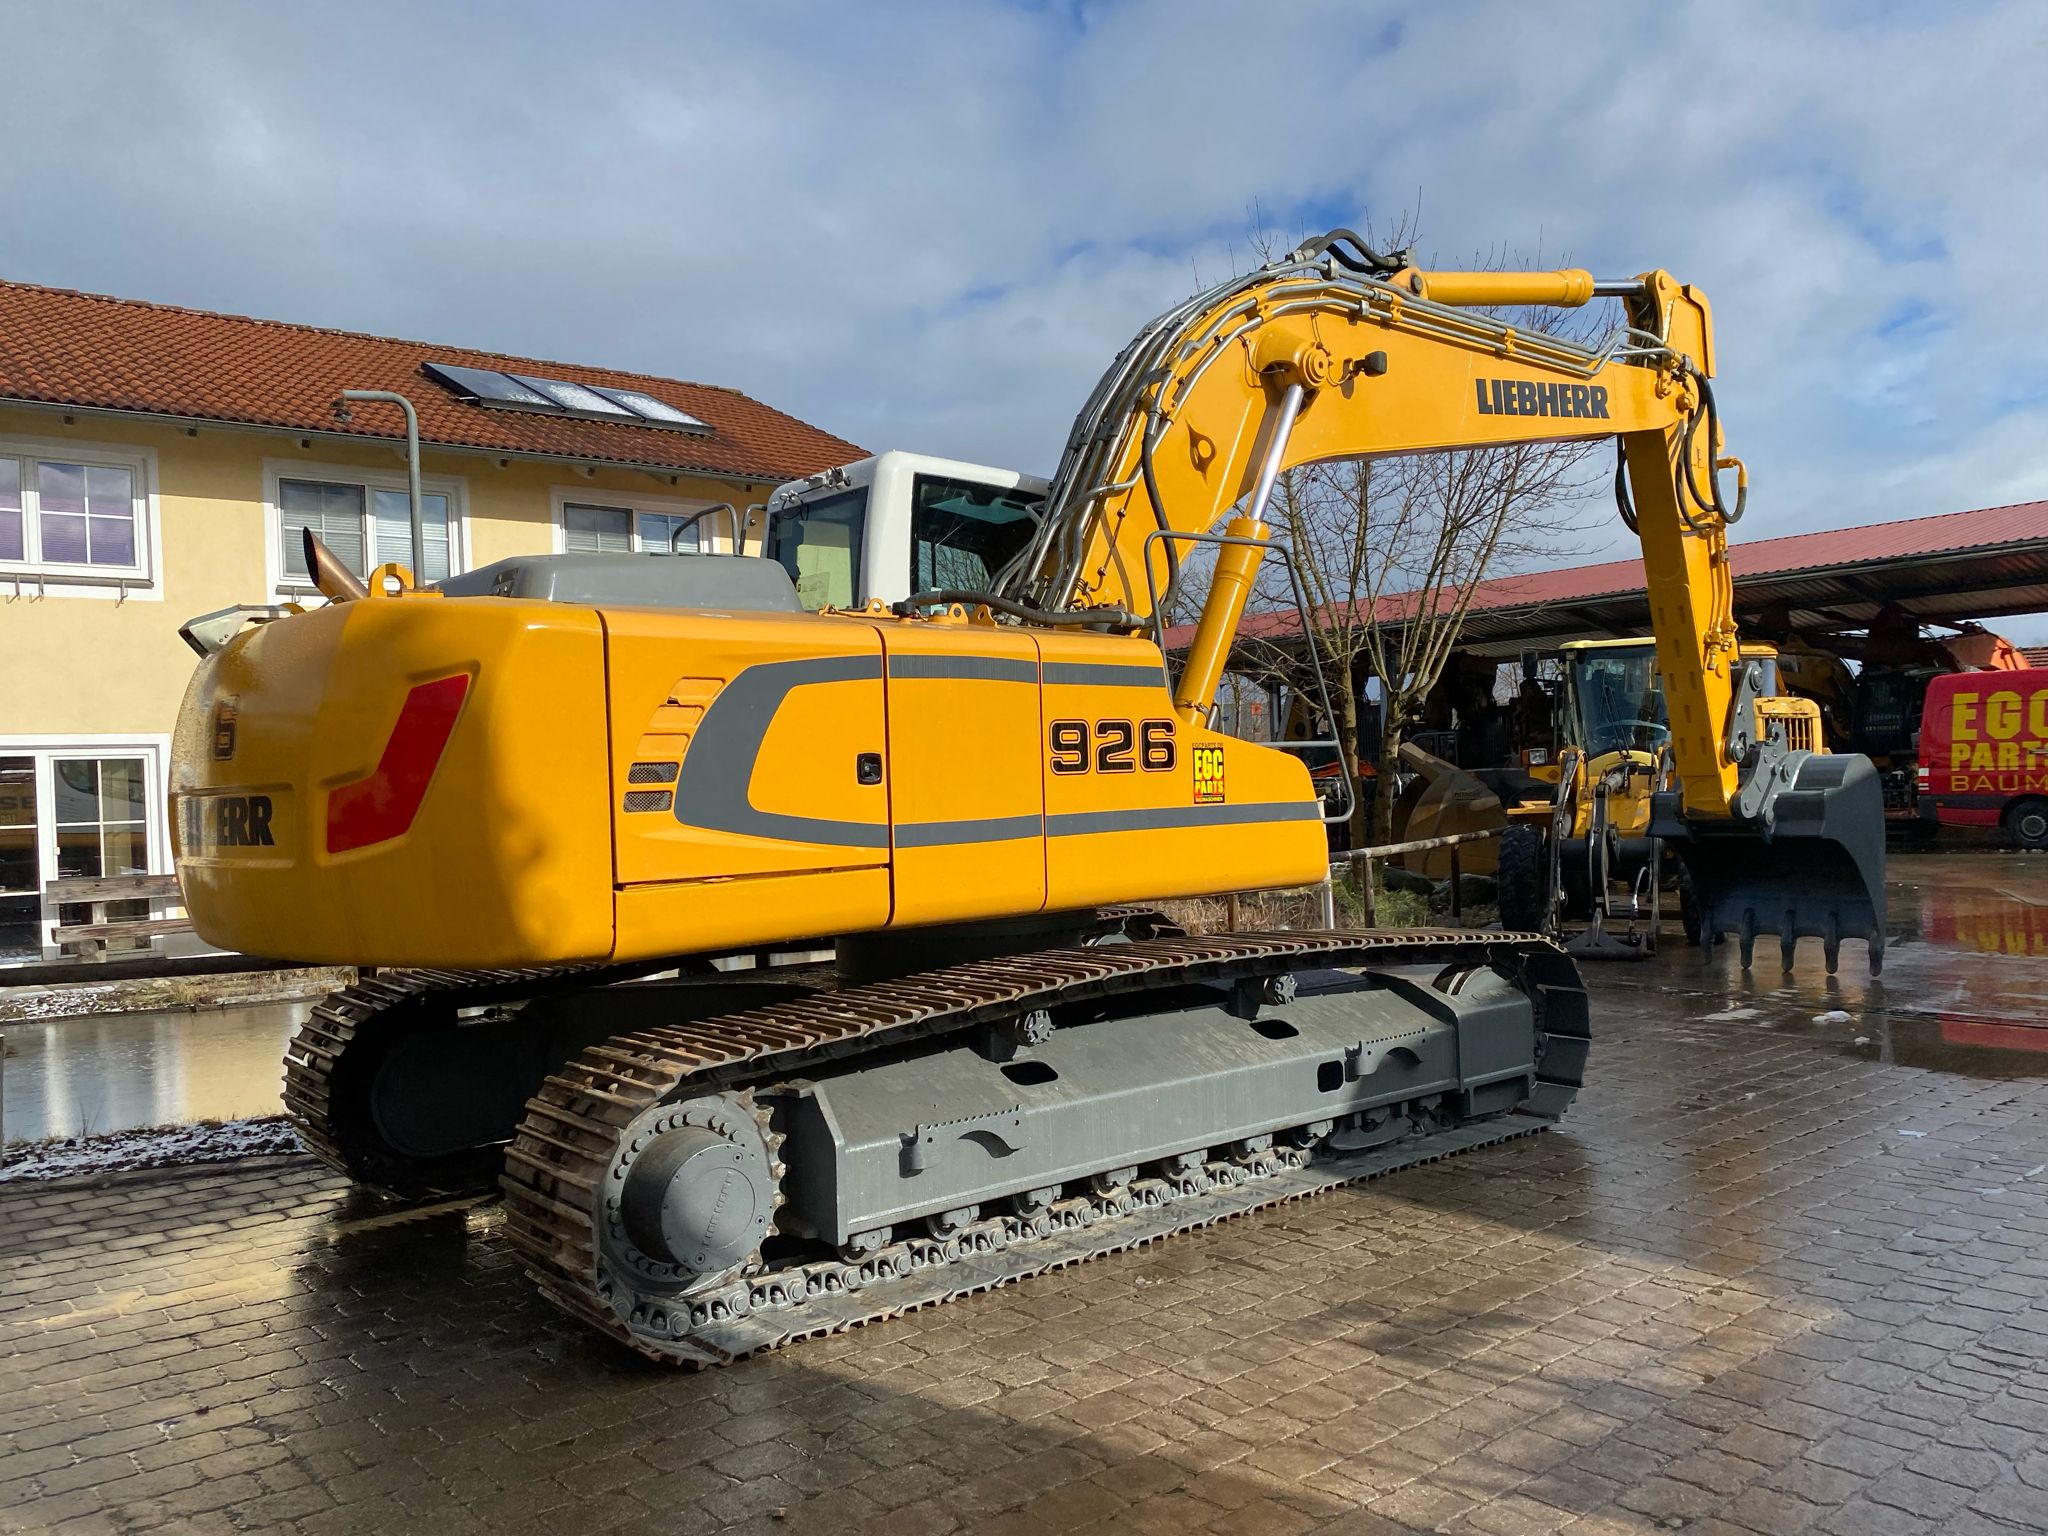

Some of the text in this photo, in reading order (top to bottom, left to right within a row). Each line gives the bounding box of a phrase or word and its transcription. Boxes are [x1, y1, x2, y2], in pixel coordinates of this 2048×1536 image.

[1476, 379, 1610, 419] LIEBHERR
[1050, 719, 1176, 775] 926
[1951, 741, 2048, 771] PART
[1194, 749, 1224, 780] EGC
[1195, 780, 1224, 794] PARTS
